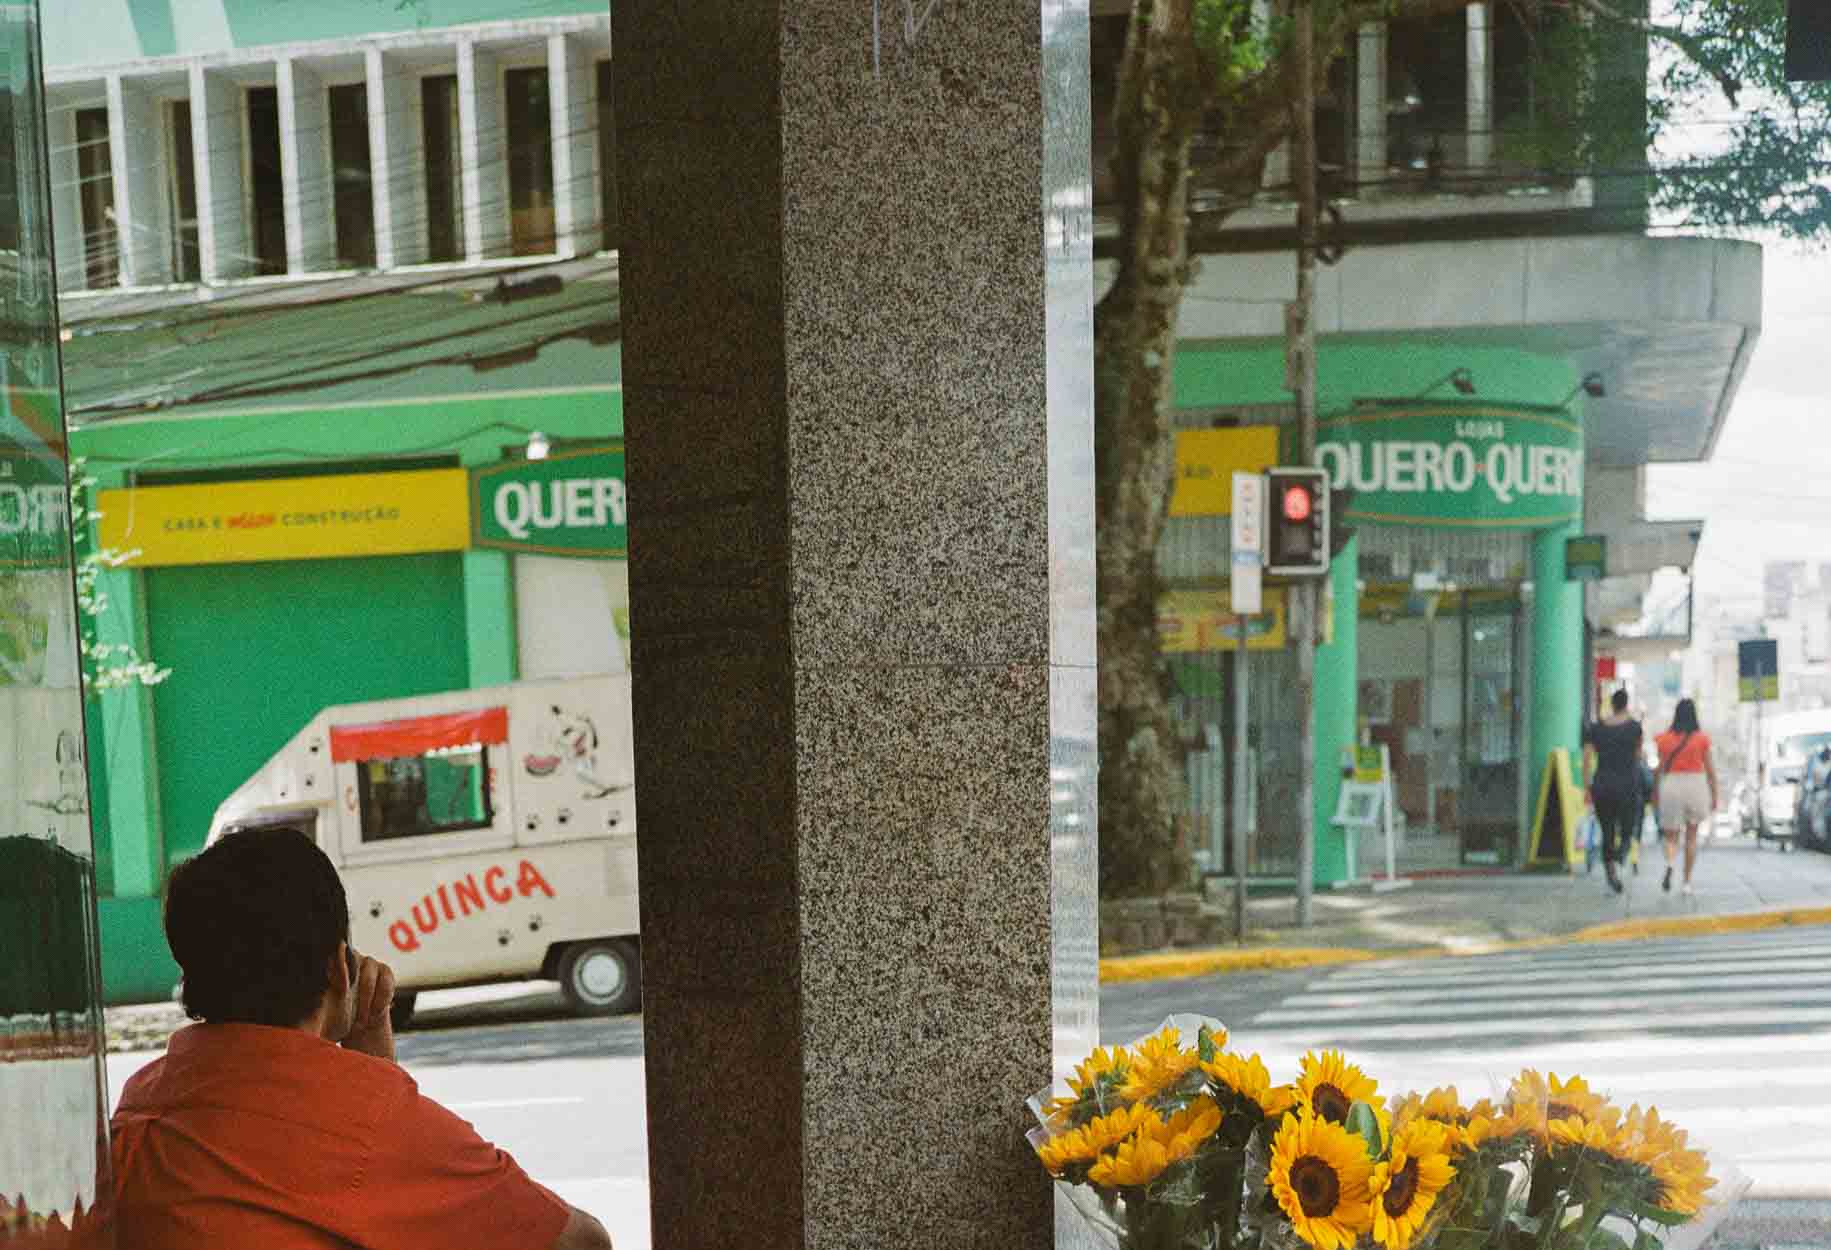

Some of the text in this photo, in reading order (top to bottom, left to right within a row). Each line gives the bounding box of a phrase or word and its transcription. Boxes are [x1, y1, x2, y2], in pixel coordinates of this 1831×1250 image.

[163, 518, 208, 532] CASA
[282, 505, 400, 527] CONSTRUÇÃO
[494, 477, 626, 539] QUER
[388, 860, 556, 952] QUINCA
